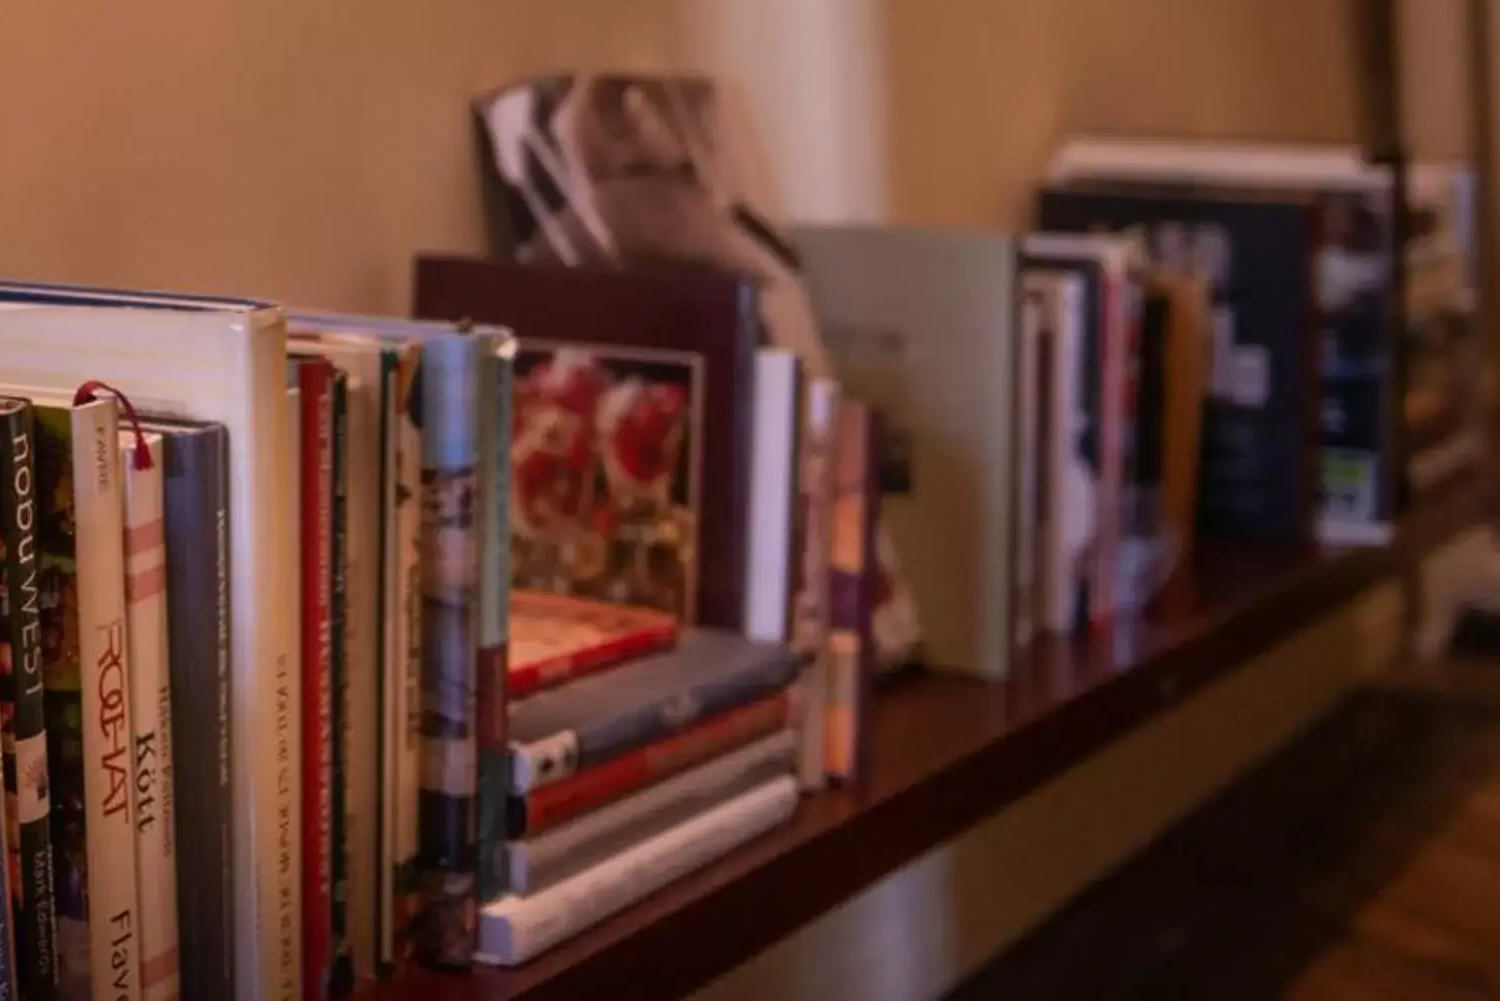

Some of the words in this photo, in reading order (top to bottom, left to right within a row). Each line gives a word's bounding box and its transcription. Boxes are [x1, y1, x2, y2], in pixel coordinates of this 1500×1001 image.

[12, 432, 35, 565] nobu
[20, 569, 44, 697] WEST
[134, 729, 157, 837] Kött
